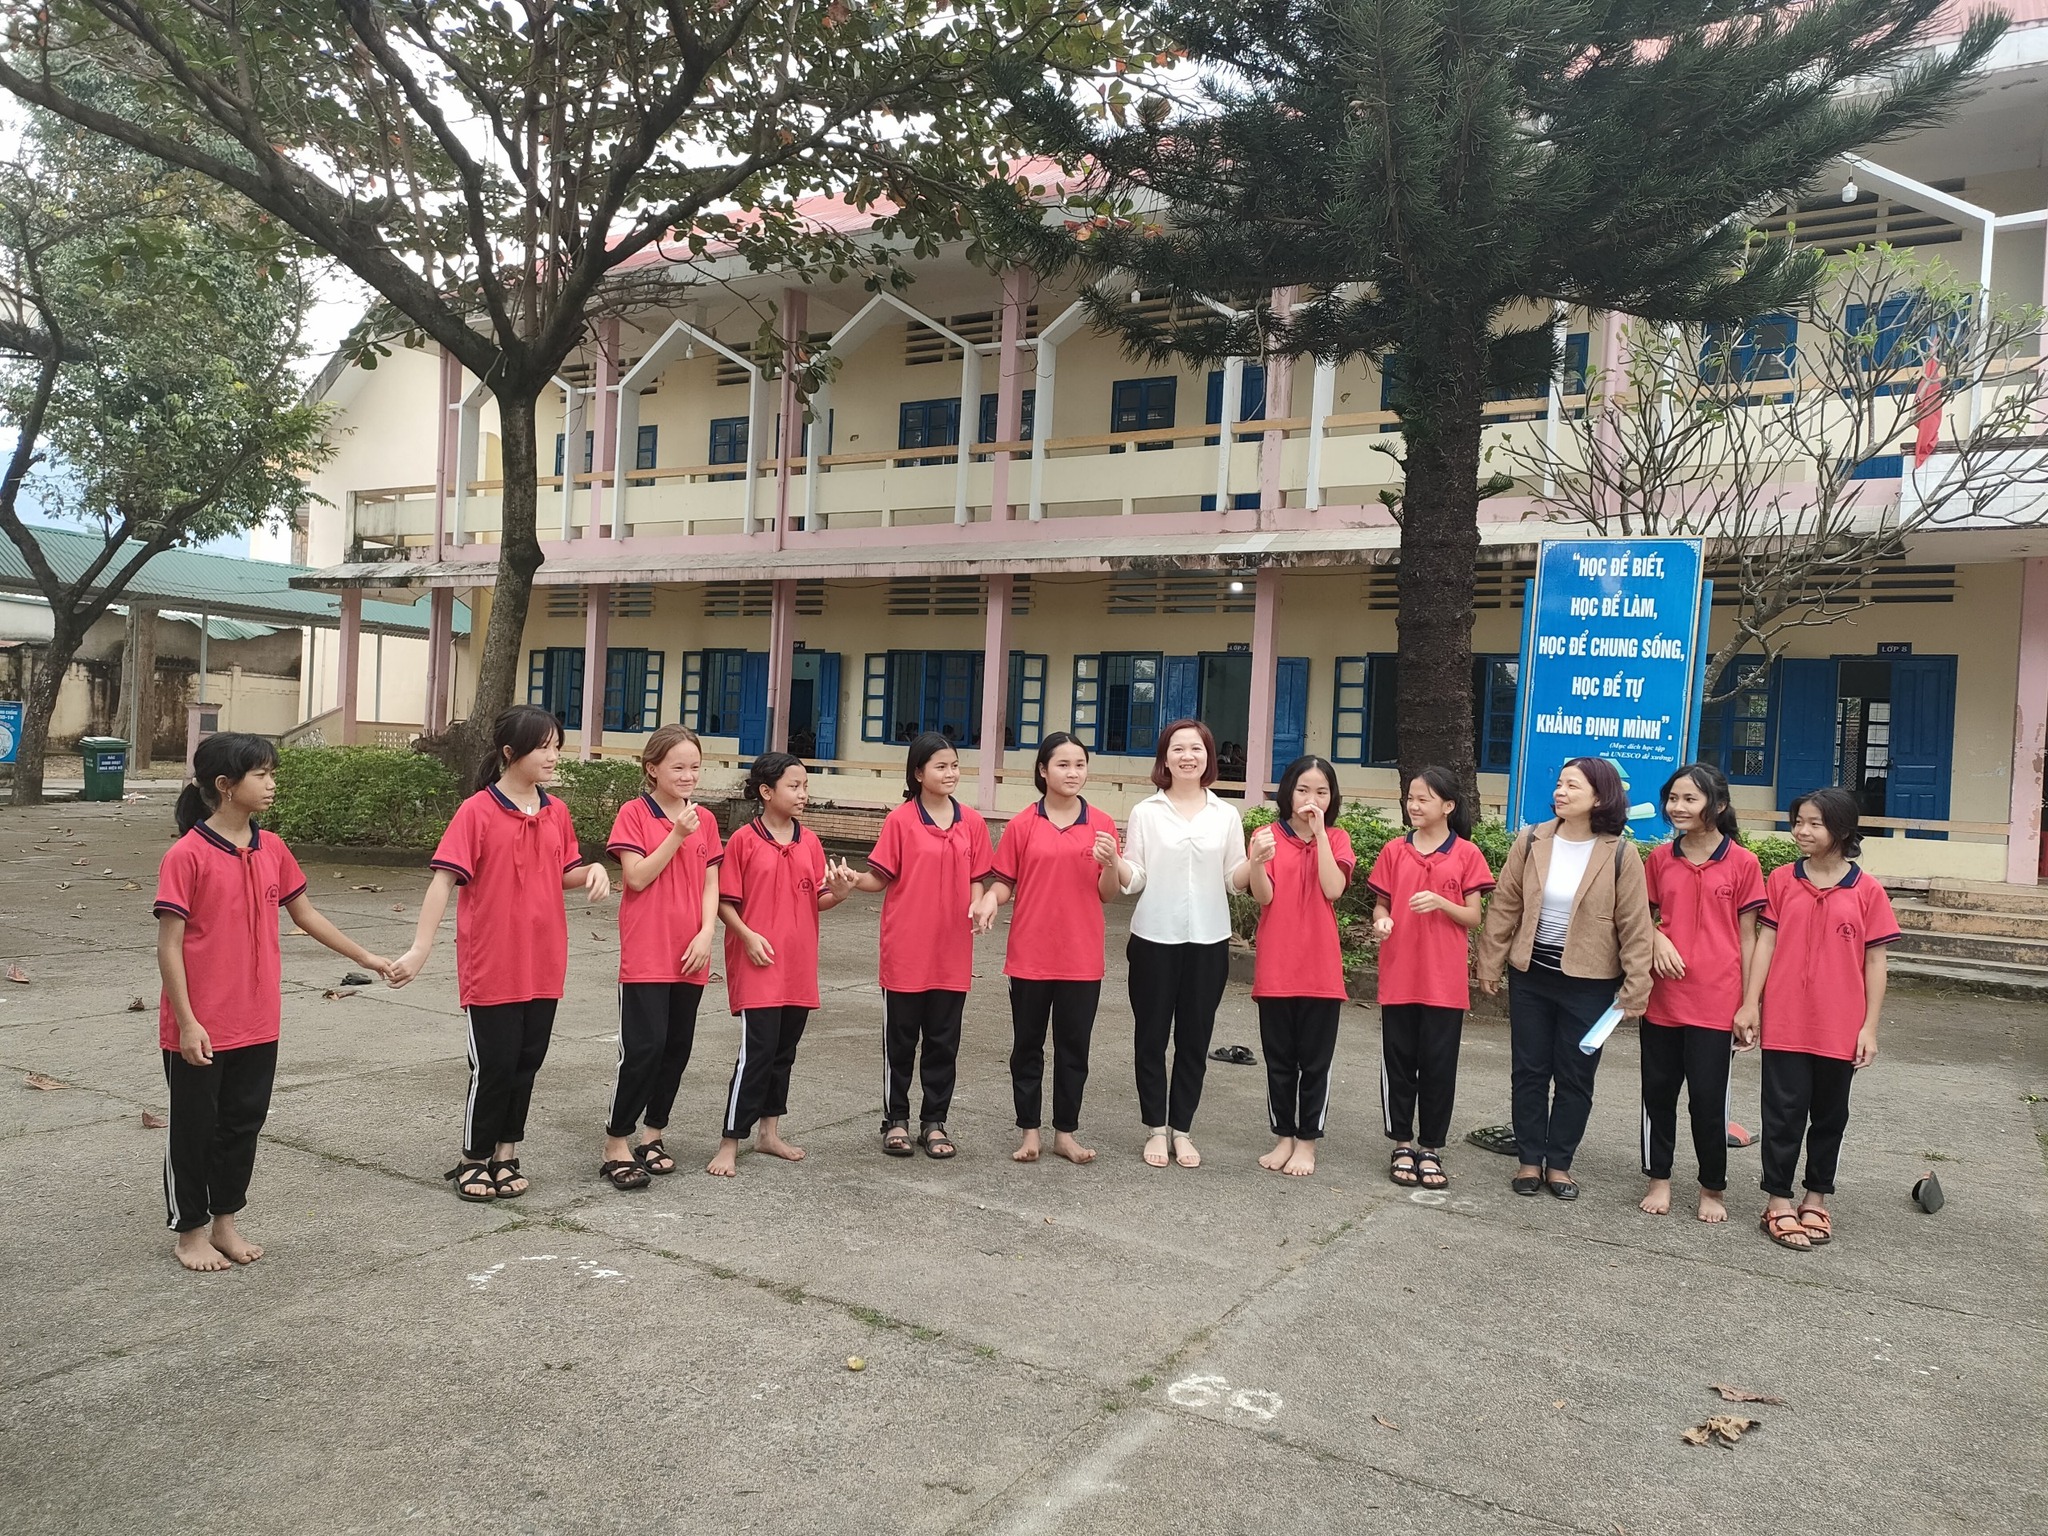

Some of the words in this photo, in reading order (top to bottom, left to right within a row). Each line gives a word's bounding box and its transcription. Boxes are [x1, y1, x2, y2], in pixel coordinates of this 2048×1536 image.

[1573, 552, 1607, 581] “HỌC
[1610, 549, 1631, 577] ĐỂ
[1632, 551, 1665, 580] BIẾT,
[1570, 597, 1599, 621] HỌC
[1601, 590, 1622, 617] ĐỂ
[1623, 594, 1658, 620] LÀM,
[1538, 636, 1566, 659] HỌC
[1569, 629, 1589, 656] ĐỂ
[1590, 637, 1639, 658] CHUNG
[1641, 632, 1685, 662] SỐNG,
[1901, 645, 1908, 653] 8
[1571, 676, 1600, 700] HỌC
[1602, 670, 1624, 697] ĐỂ
[1625, 677, 1645, 702] TỰ
[1585, 716, 1620, 740] ĐỊNH
[1610, 751, 1641, 759] UNESCO
